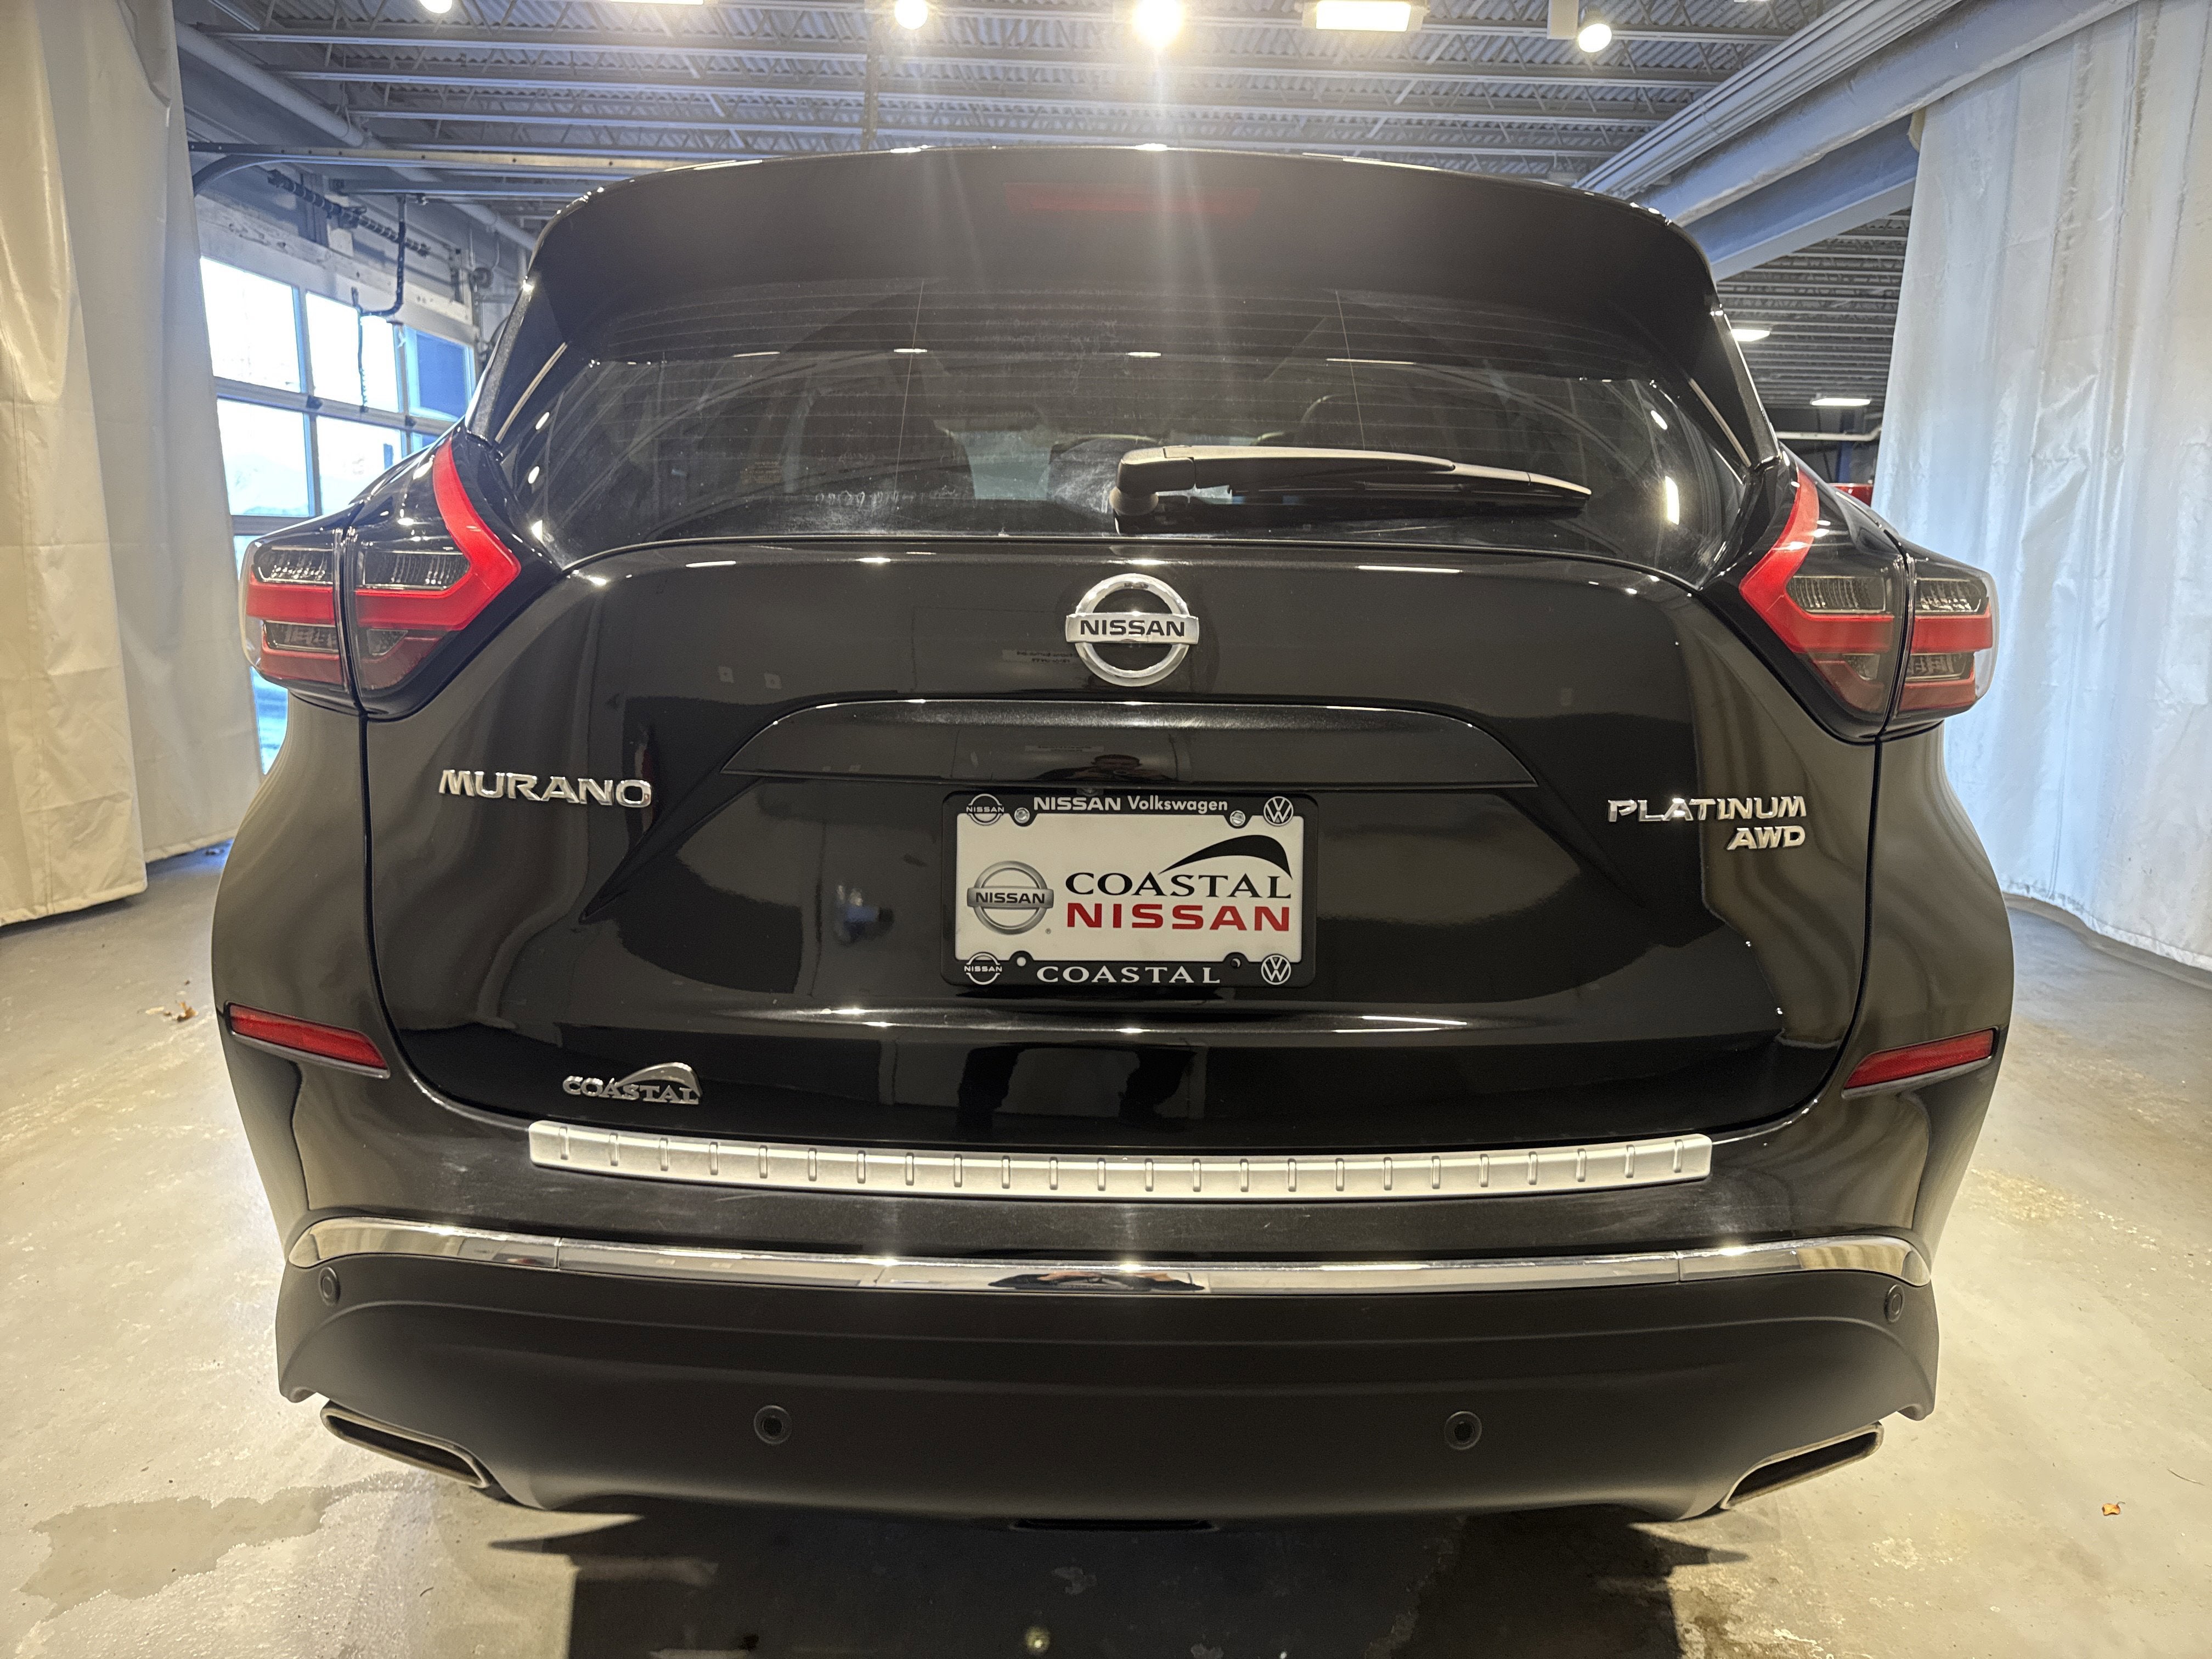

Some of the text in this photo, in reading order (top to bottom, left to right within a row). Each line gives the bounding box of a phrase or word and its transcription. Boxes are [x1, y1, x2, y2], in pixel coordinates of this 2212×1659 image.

[1080, 620, 1185, 637] NISSAN
[439, 770, 652, 808] MURANO
[1034, 795, 1228, 814] NISSAN Volkswagen
[1607, 796, 1807, 822] PLATINUM
[1726, 825, 1805, 850] AWD
[975, 891, 1045, 904] NISSAN
[1065, 872, 1291, 899] COASTAL
[1067, 903, 1290, 932] NISSAN
[1036, 966, 1221, 984] COASTAL
[562, 1076, 699, 1104] COASTAL
